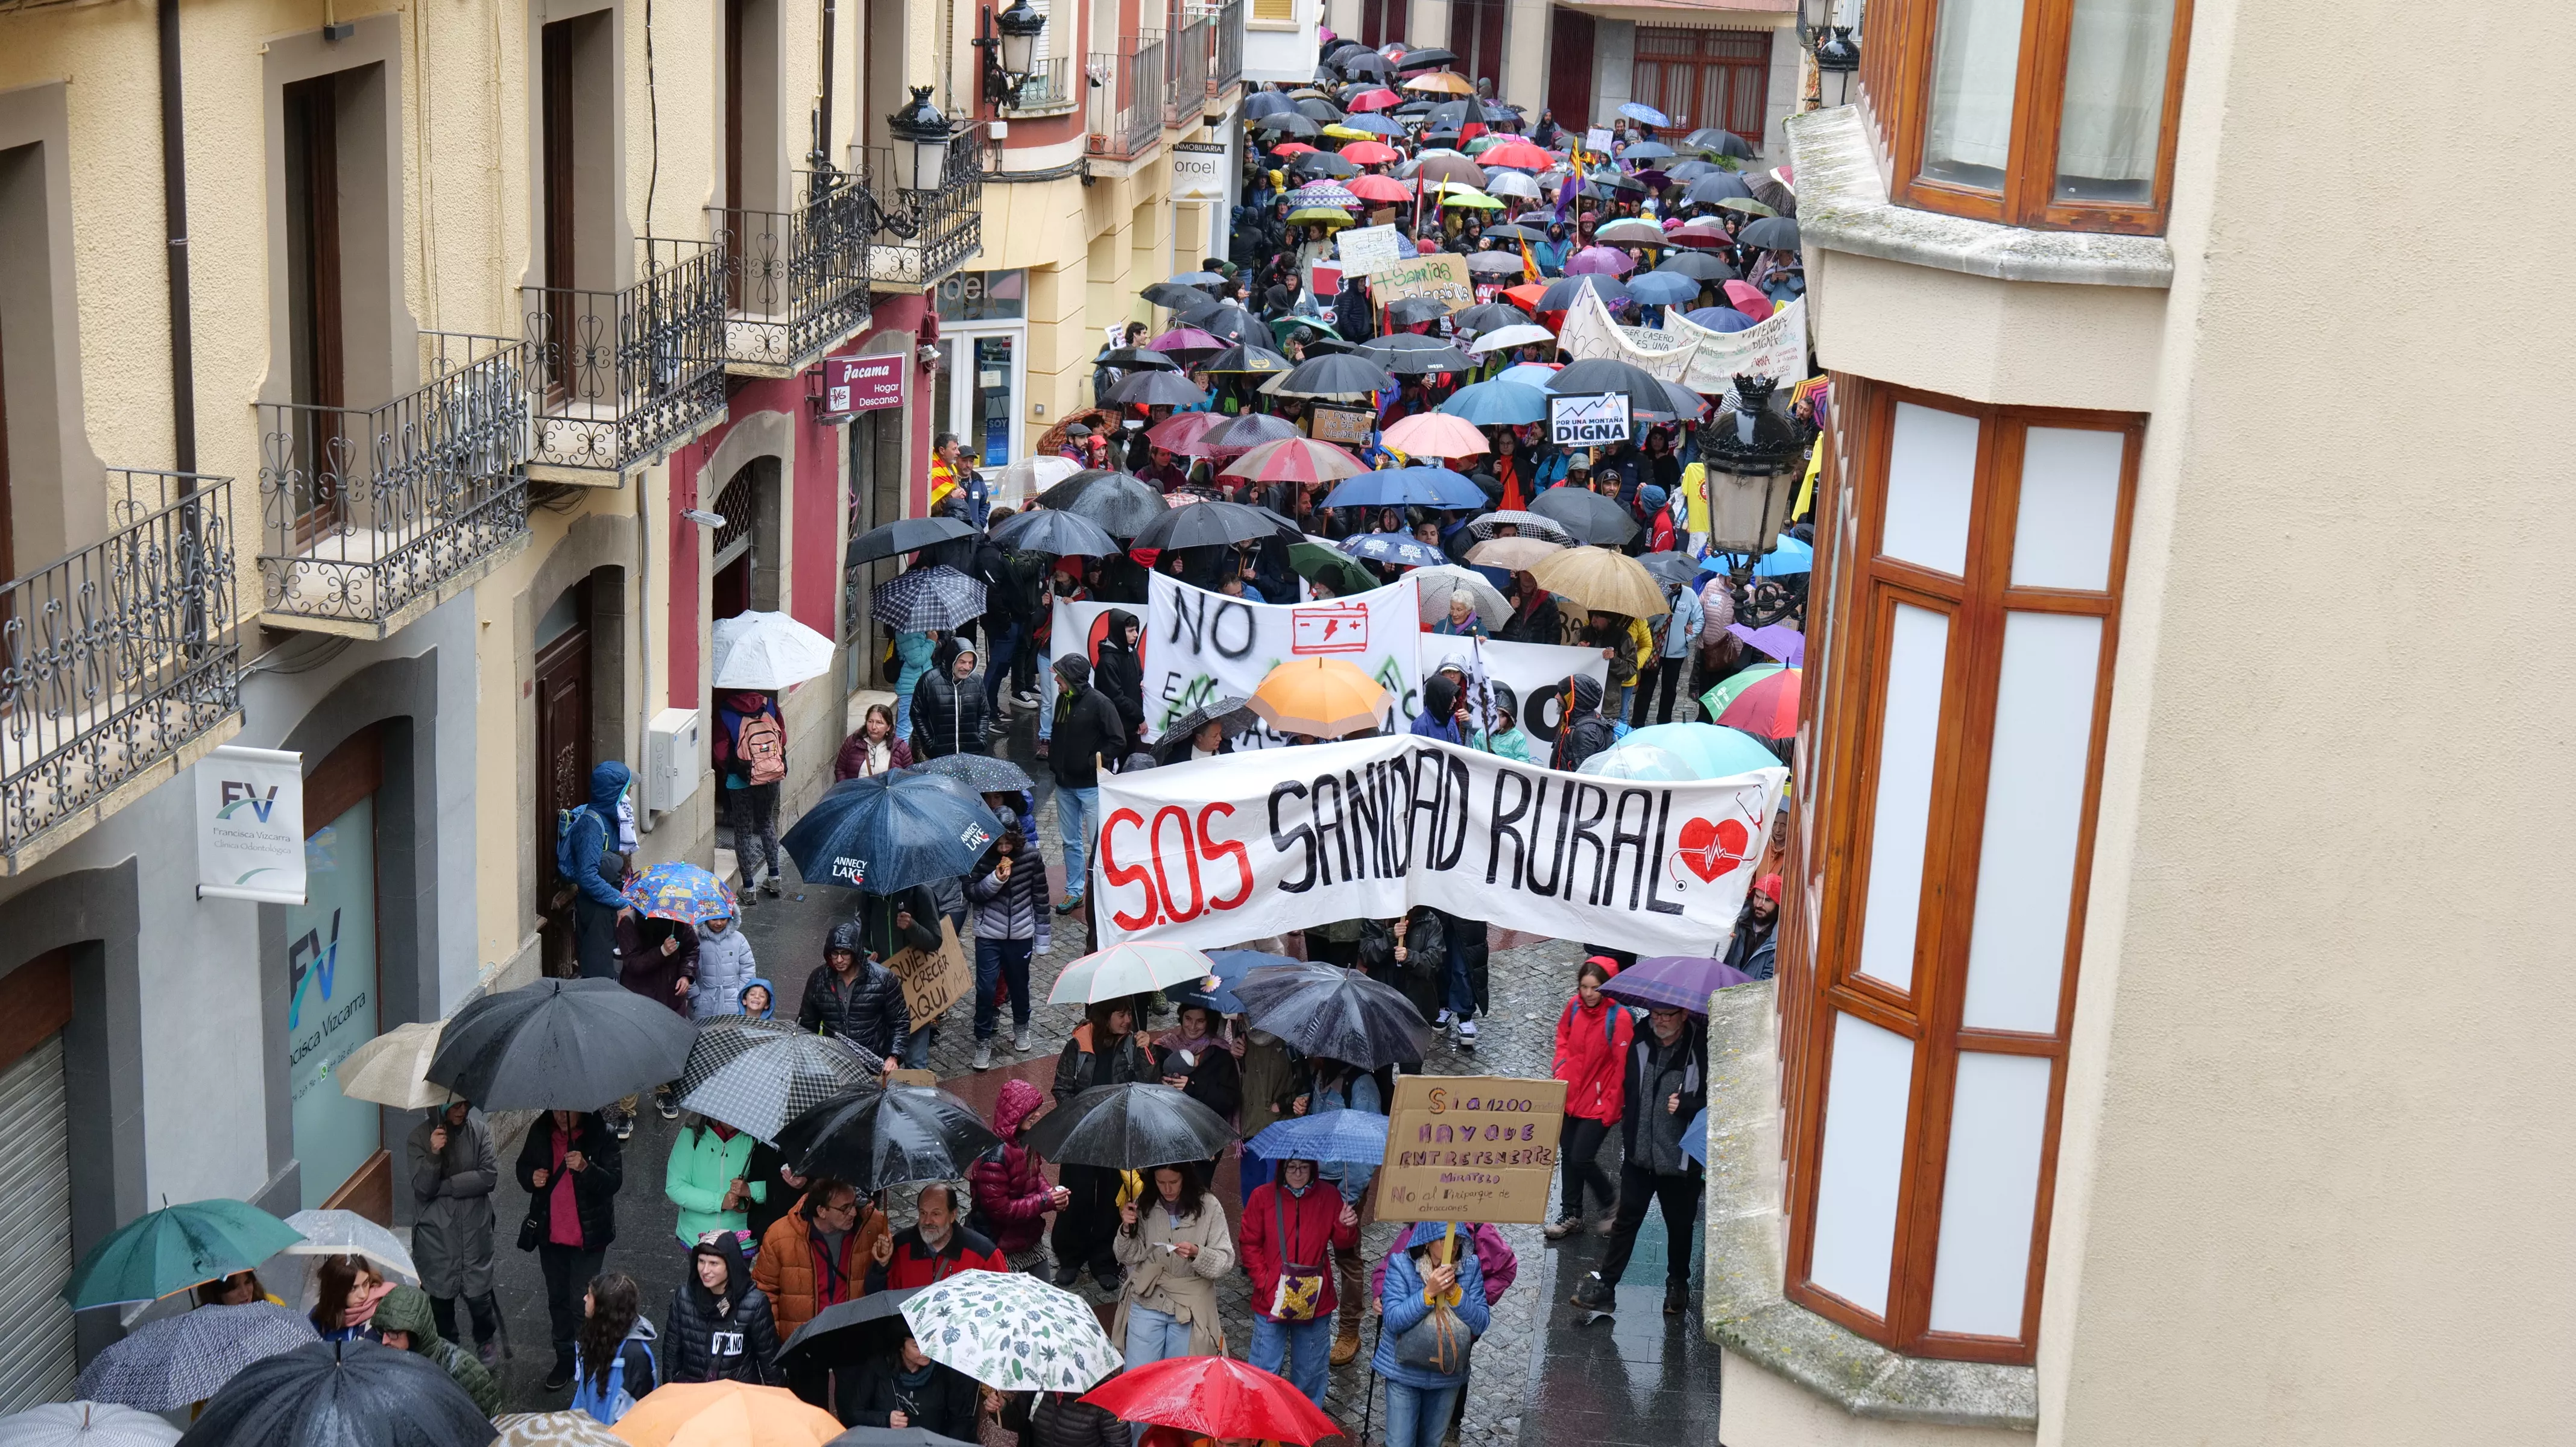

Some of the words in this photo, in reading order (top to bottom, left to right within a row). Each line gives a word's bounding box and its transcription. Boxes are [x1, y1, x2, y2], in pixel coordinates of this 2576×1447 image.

[1175, 143, 1222, 153] INMOBILIARIA
[1175, 160, 1215, 174] oroel
[1182, 169, 1220, 183] CASA
[1623, 329, 1640, 337] SER
[1643, 330, 1675, 343] CASERO
[1741, 316, 1788, 339] VIVIENDA
[1652, 342, 1670, 351] UNA
[1752, 335, 1779, 350] DIGNA
[844, 364, 889, 383] Jacama
[874, 383, 899, 394] Hogar
[859, 396, 898, 406] Descanso
[988, 418, 1008, 429] SOY
[1316, 410, 1330, 420] EL
[1333, 411, 1364, 423] PIRINEO
[1324, 420, 1338, 429] NO
[1340, 421, 1354, 430] SE
[1589, 416, 1624, 424] MONTAÑA
[1556, 424, 1626, 441] DIGNA
[1170, 585, 1255, 660] NO
[1162, 671, 1218, 708] EN
[218, 780, 278, 823] FV
[213, 827, 254, 839] Francisca
[256, 831, 291, 842] Vizcarra
[960, 820, 979, 844] ANNECY
[965, 828, 987, 851] LAKE
[1269, 747, 1470, 895] SANIDAD
[1486, 768, 1685, 916] RURAL
[240, 842, 291, 856] Odontológica
[833, 856, 868, 869] ANNECY
[832, 865, 865, 882] LAKE
[912, 954, 950, 993] CRECER
[908, 978, 949, 1022] AQUÍ
[323, 992, 365, 1038] Vizcarra
[1428, 1087, 1459, 1114] Si
[1466, 1097, 1481, 1111] a
[1486, 1098, 1532, 1112] 1200
[1418, 1123, 1476, 1144] HAY
[1485, 1123, 1535, 1141] QUE
[1399, 1146, 1553, 1170] ENTRETENERTE
[1391, 1186, 1416, 1204] No
[1422, 1186, 1437, 1200] al
[1444, 1187, 1492, 1205] Piriparque
[1499, 1189, 1510, 1200] de
[1419, 1205, 1468, 1213] atracciones
[732, 1335, 742, 1352] NO
